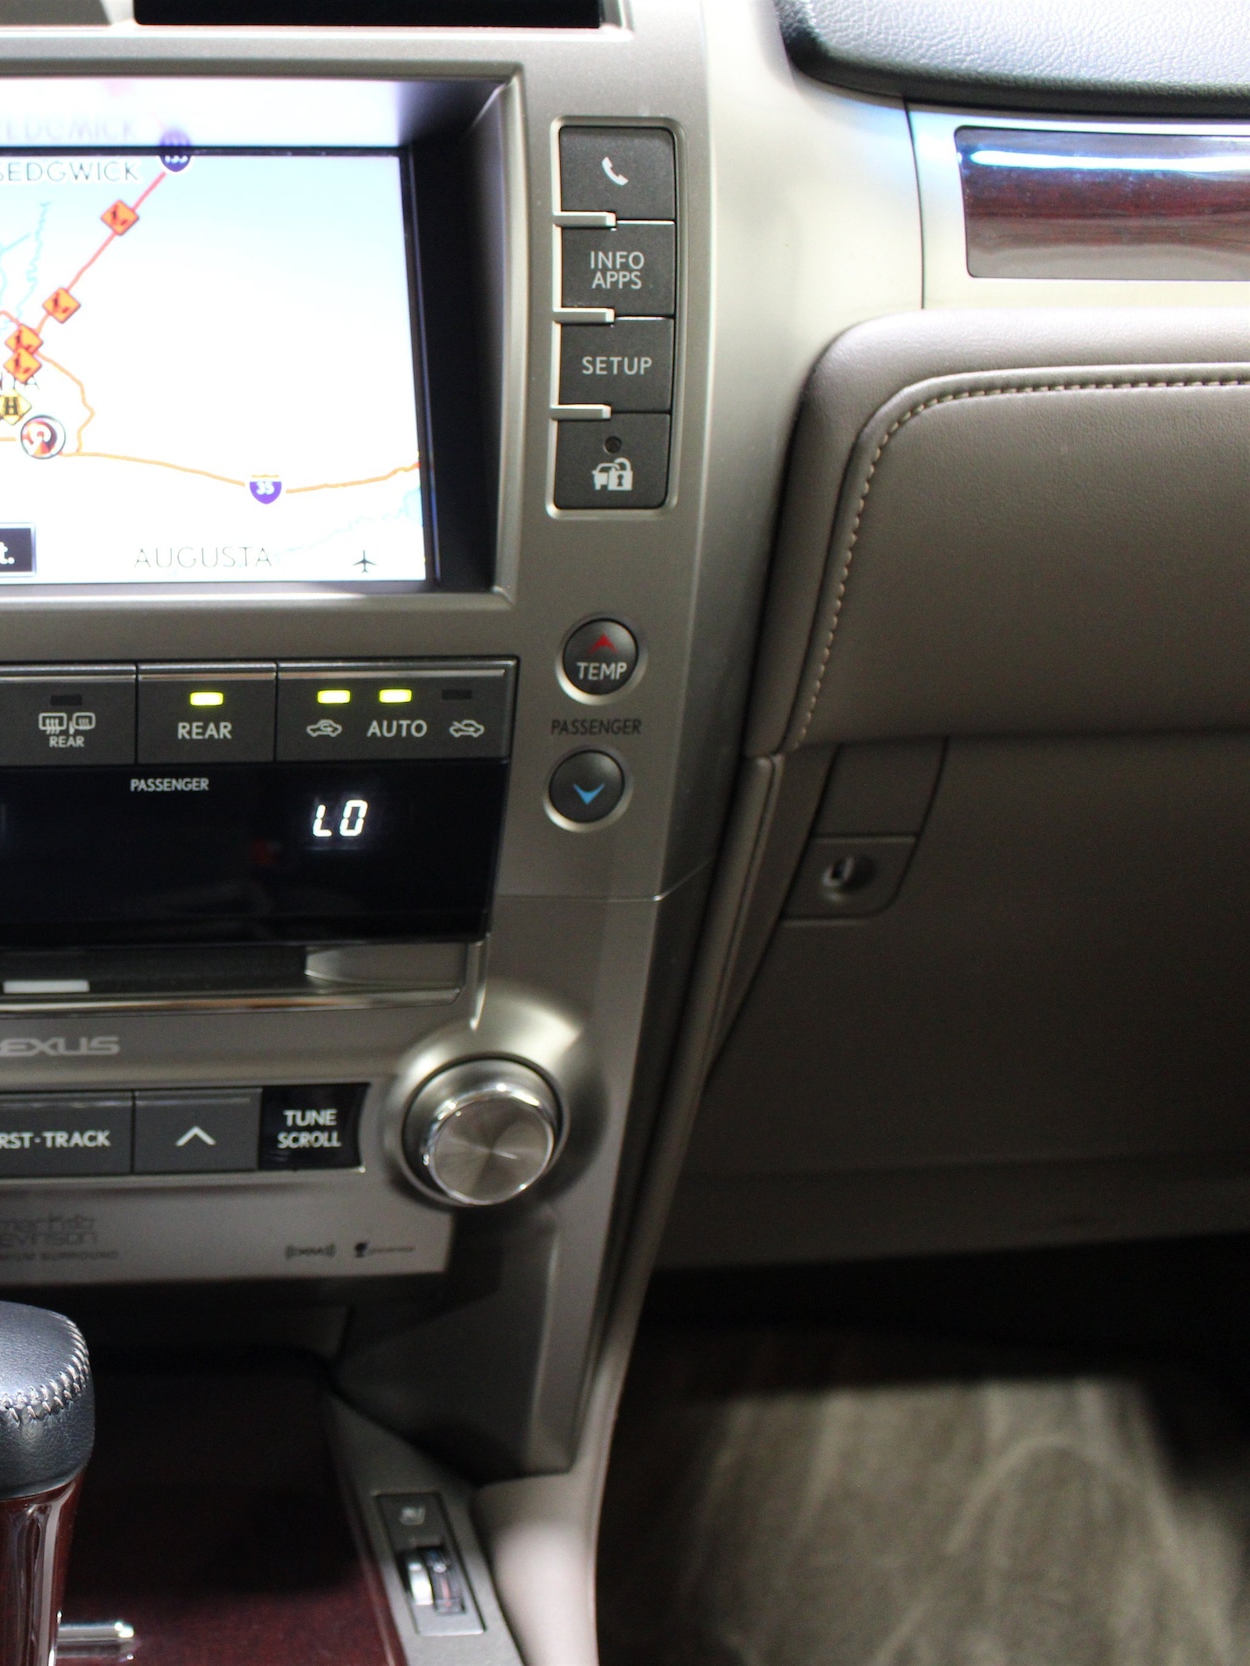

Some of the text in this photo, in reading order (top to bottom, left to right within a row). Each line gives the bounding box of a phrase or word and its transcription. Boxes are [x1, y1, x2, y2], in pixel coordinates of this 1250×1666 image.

[589, 251, 645, 270] INFO
[591, 271, 642, 290] APPS
[582, 356, 653, 375] SETUP
[256, 479, 275, 495] 35
[134, 546, 273, 569] AUGUSTA
[576, 661, 628, 681] TEMP
[177, 722, 232, 740] REAR
[366, 720, 428, 738] AUTO
[551, 718, 642, 736] PASSENGER
[49, 736, 85, 748] REAR
[130, 778, 209, 792] PASSENGER
[312, 799, 368, 838] LO
[283, 1109, 338, 1127] TUNE
[277, 1130, 342, 1149] SCROLL
